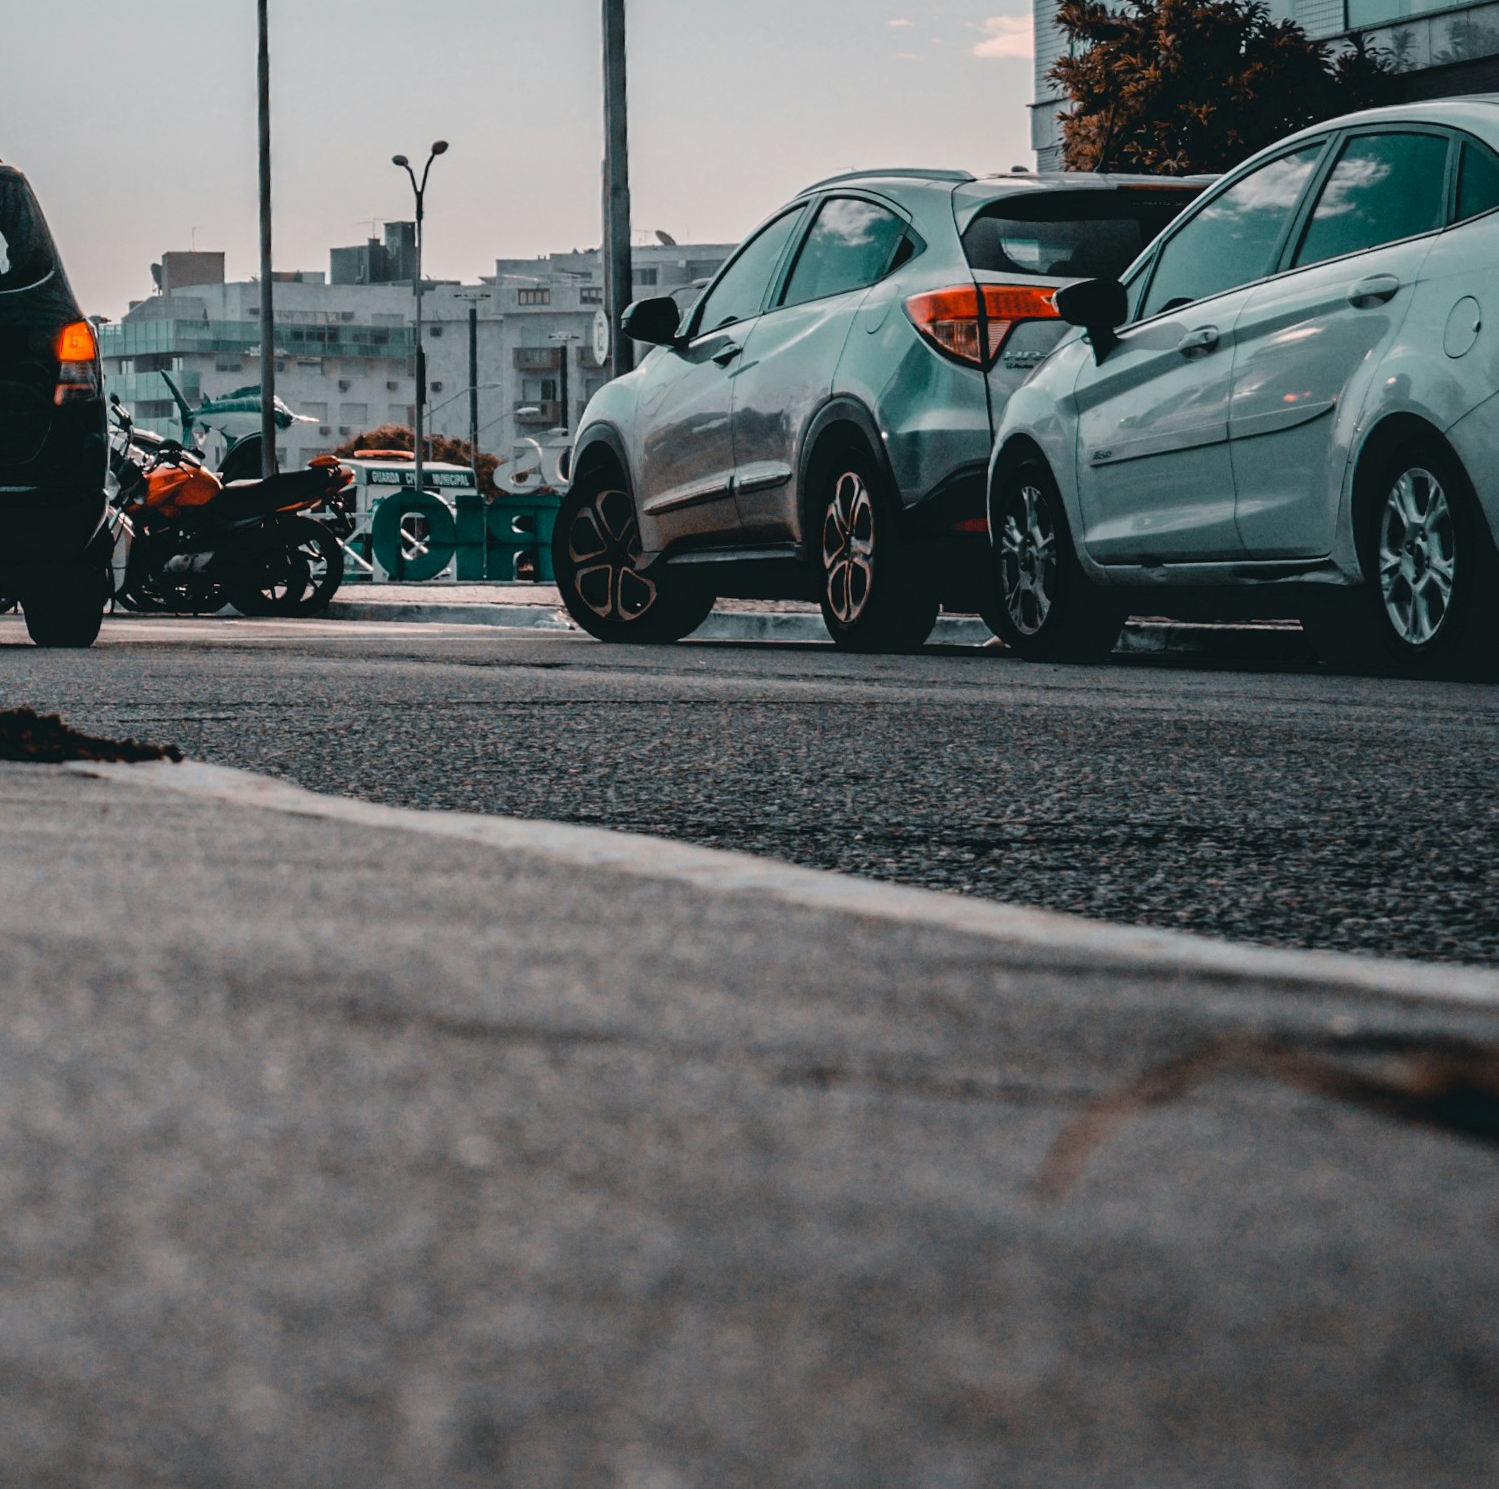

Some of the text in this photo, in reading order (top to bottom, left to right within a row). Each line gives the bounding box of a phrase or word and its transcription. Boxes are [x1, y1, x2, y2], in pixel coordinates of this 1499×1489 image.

[1005, 351, 1046, 360] HR-
[371, 471, 470, 486] GUARDA CIV MUNICIPAL
